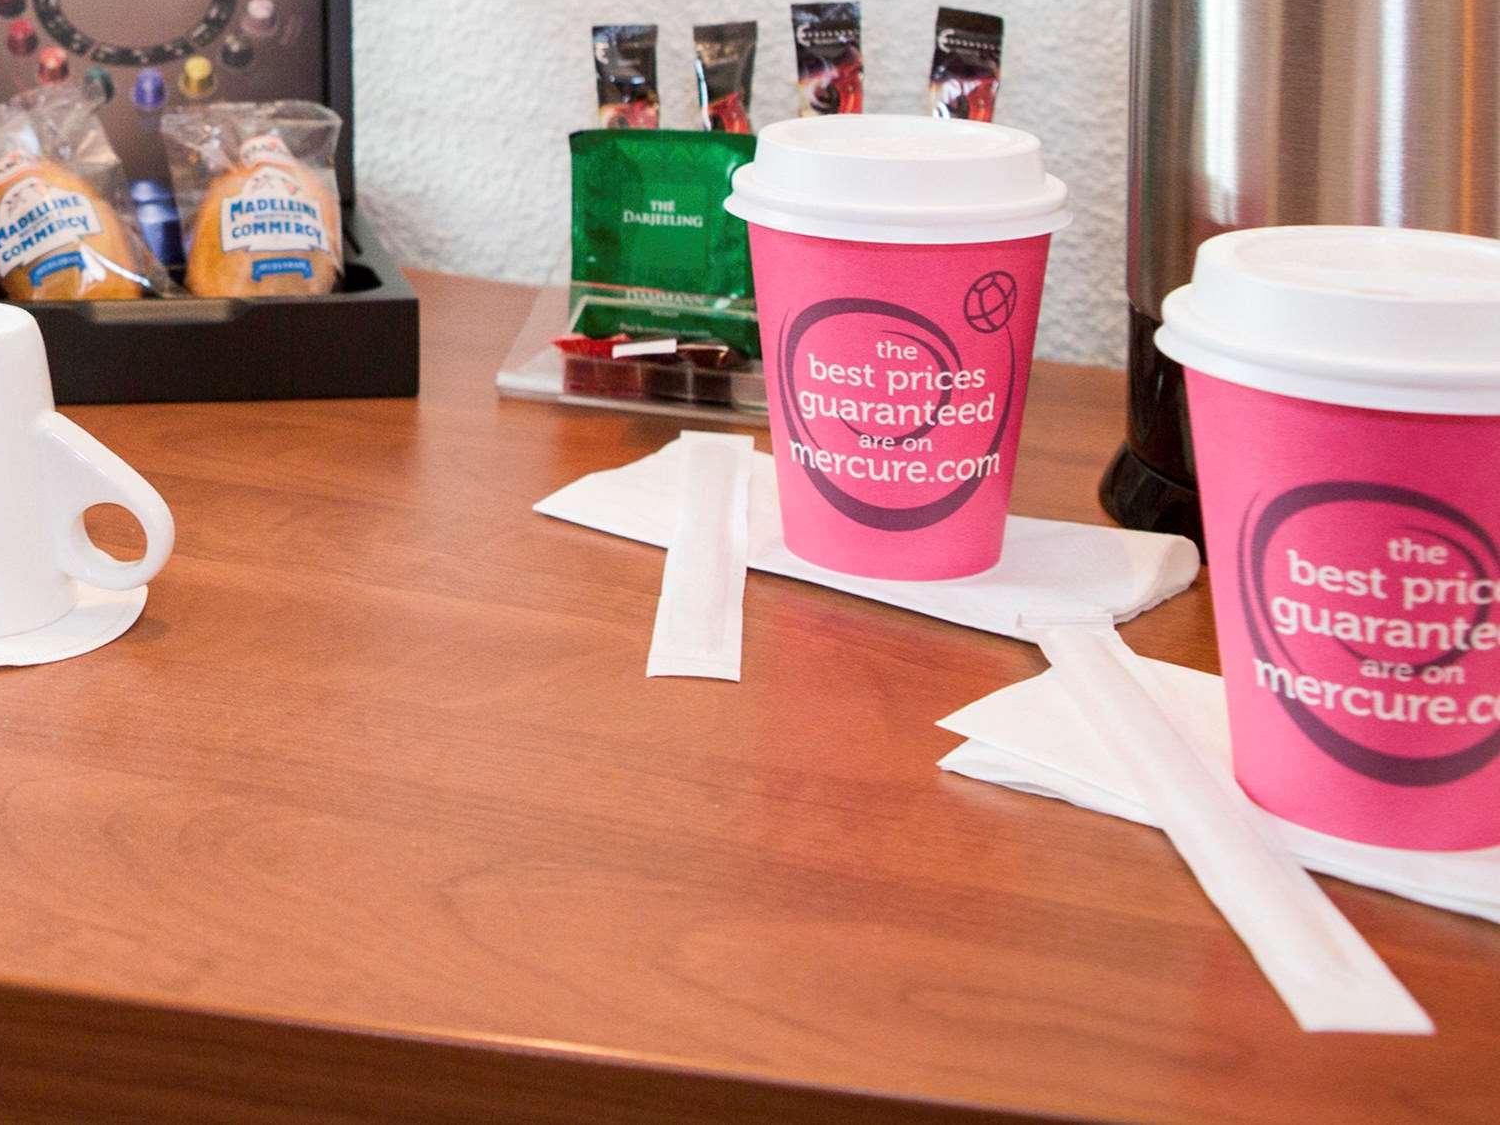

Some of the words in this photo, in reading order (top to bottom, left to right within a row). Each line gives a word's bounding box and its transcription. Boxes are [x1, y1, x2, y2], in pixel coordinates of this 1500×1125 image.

[232, 221, 322, 245] COMMERCY
[875, 340, 919, 360] the
[808, 353, 876, 389] best
[887, 368, 987, 396] prices
[799, 390, 996, 427] guaranteed
[788, 438, 1001, 484] mercure.com
[858, 433, 897, 452] are
[901, 436, 933, 452] on
[1387, 537, 1449, 565] the
[1287, 548, 1388, 600] best
[1270, 595, 1500, 651] guarante
[1360, 658, 1415, 682] are
[1422, 664, 1466, 685] on
[1253, 657, 1500, 725] mercure.c
